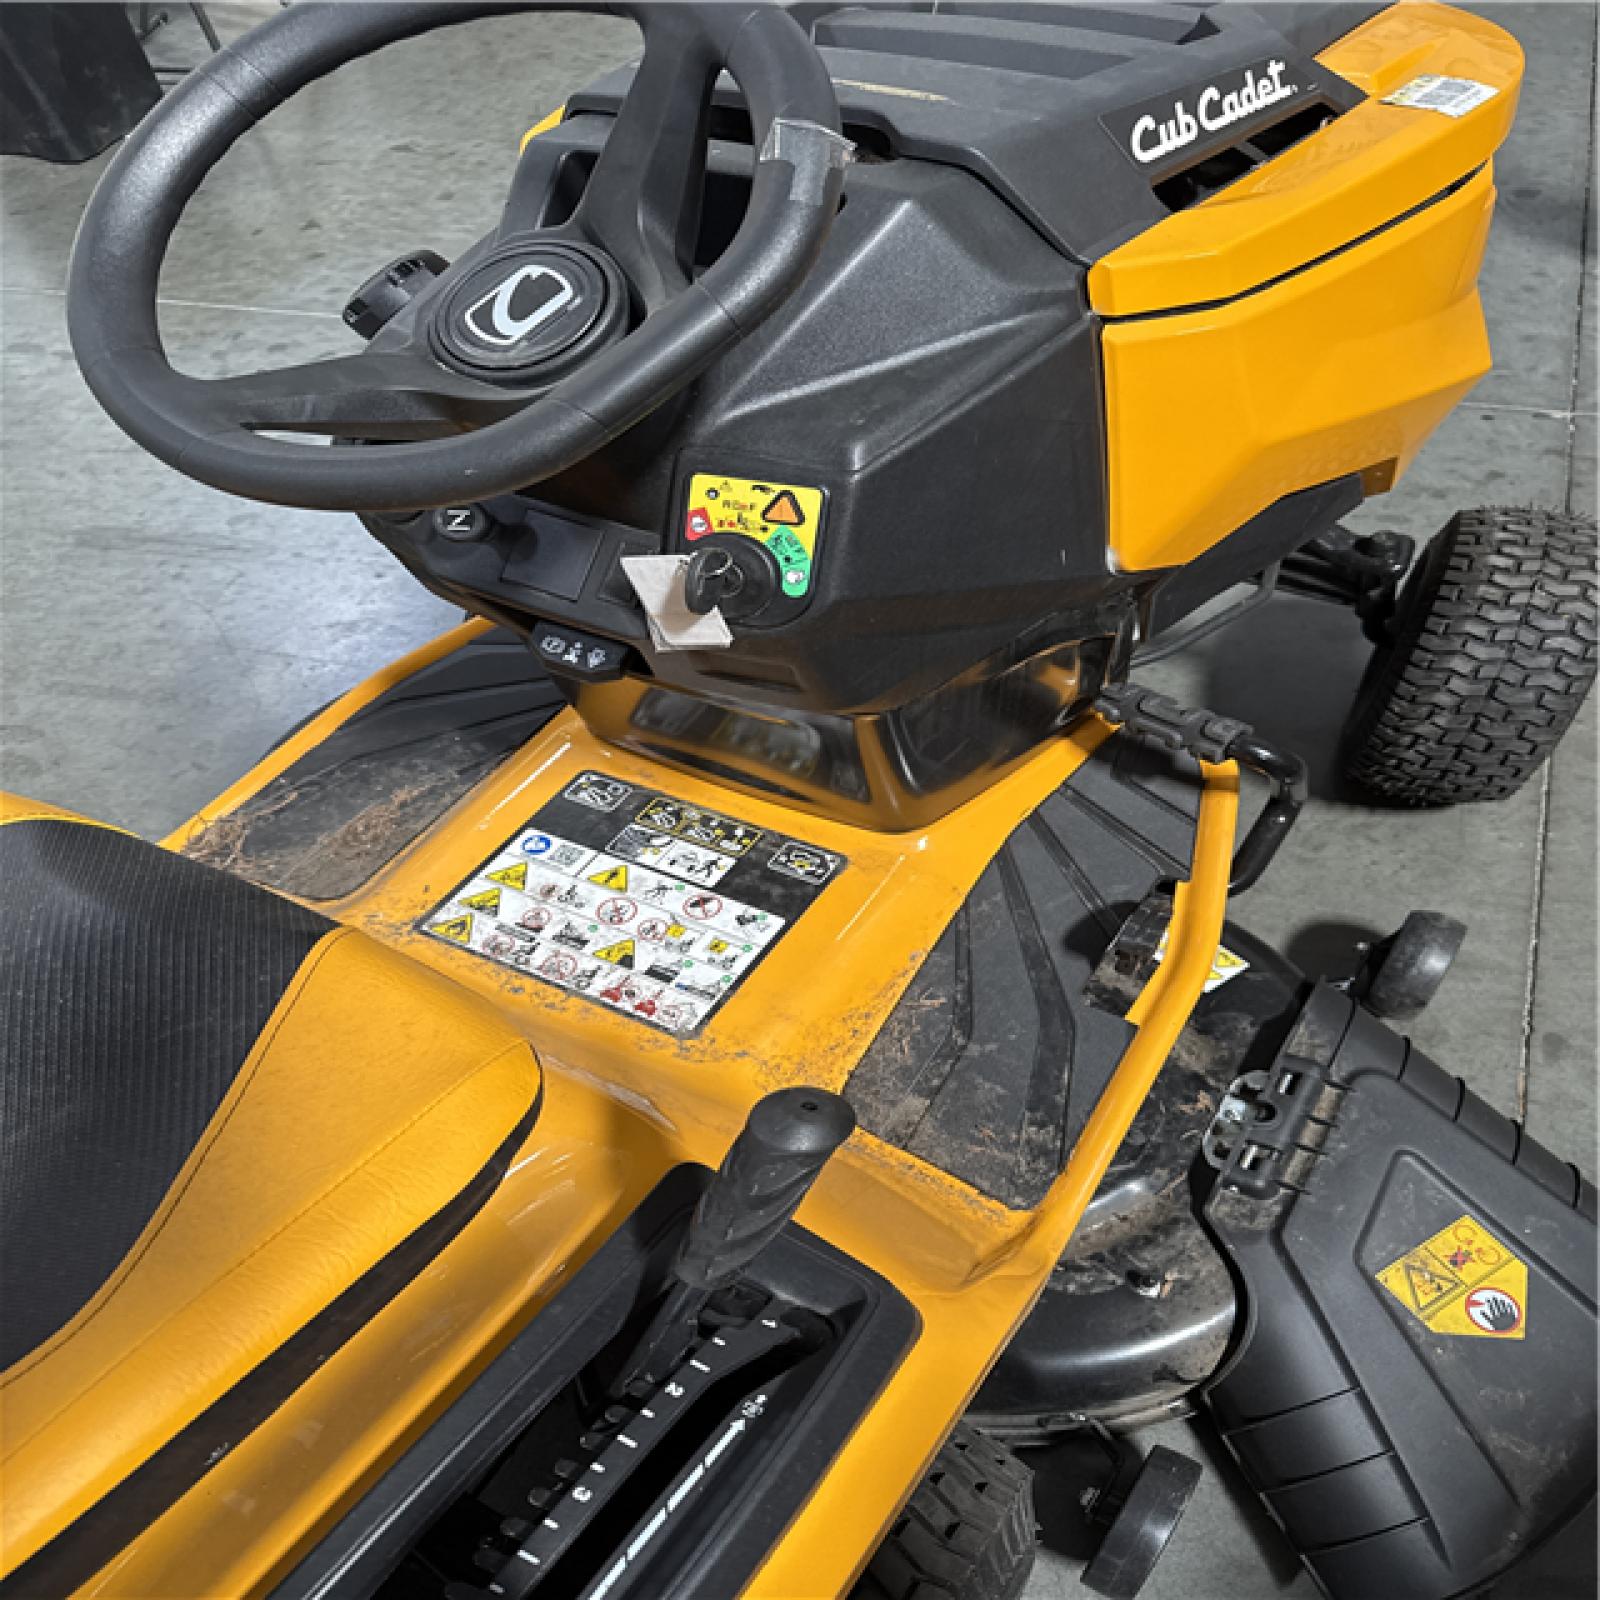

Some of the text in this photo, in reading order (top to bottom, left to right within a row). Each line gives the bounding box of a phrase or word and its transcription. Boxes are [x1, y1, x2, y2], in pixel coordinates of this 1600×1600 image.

[1131, 59, 1291, 163] Cub Cadet
[664, 1381, 685, 1398] 2
[571, 1485, 593, 1503] 3
